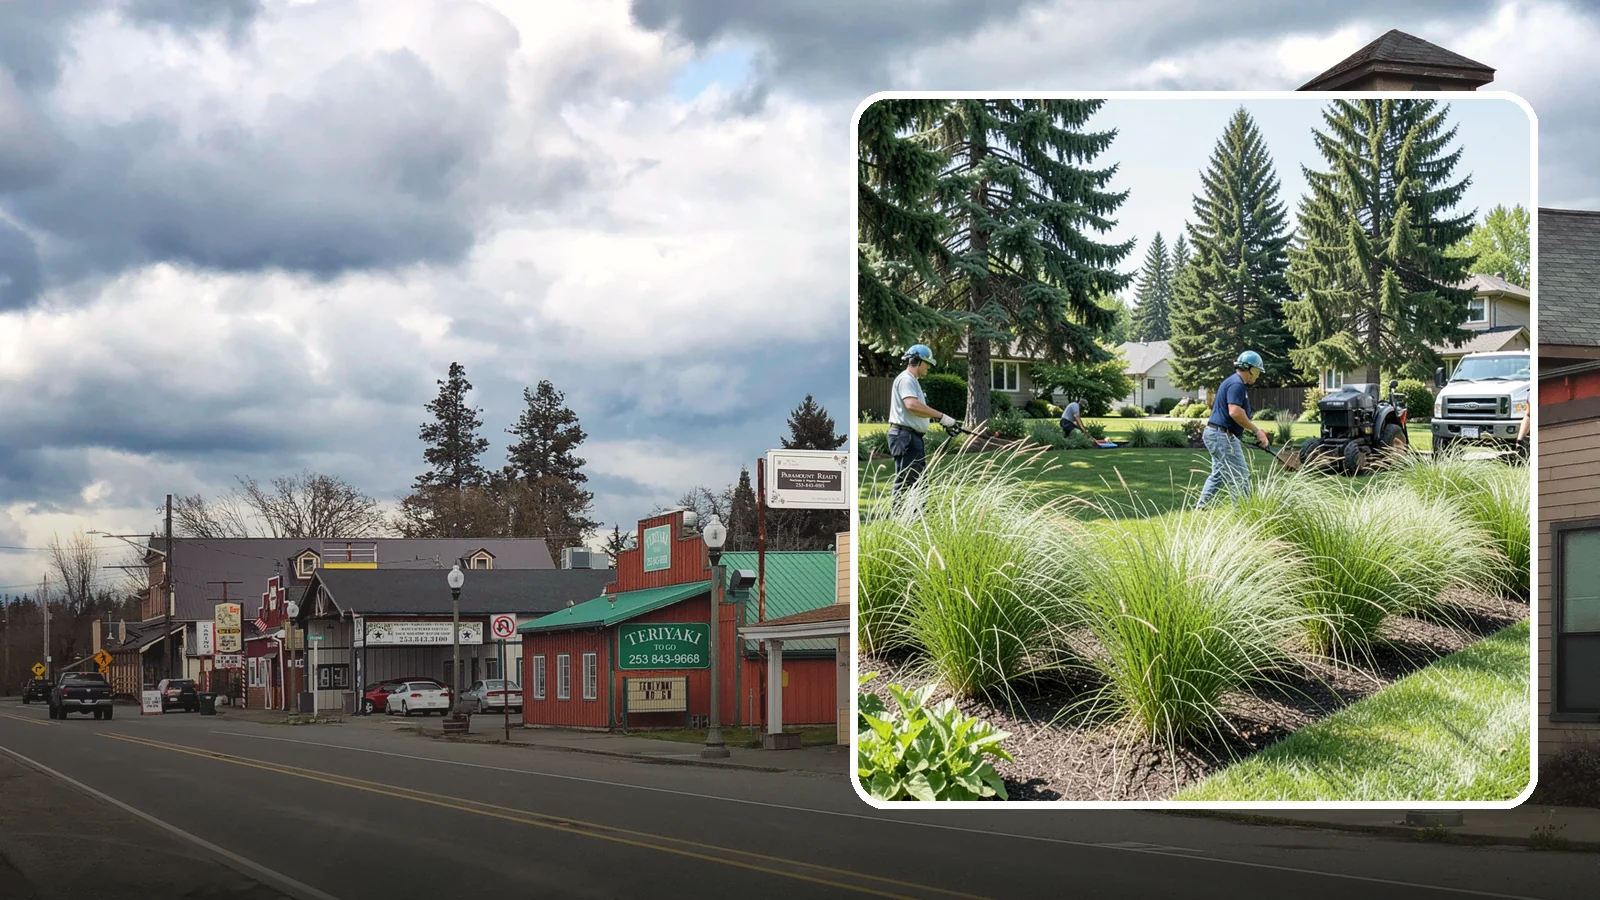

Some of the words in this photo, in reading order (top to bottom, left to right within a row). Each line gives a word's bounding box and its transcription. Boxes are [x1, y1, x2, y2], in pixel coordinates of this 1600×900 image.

[781, 471, 814, 479] PARAMOUNT
[817, 472, 839, 480] REALTY
[625, 627, 702, 646] TERIYAKI
[629, 654, 648, 664] 253
[651, 654, 700, 664] 843-9668
[639, 681, 672, 691] TERIYAKI
